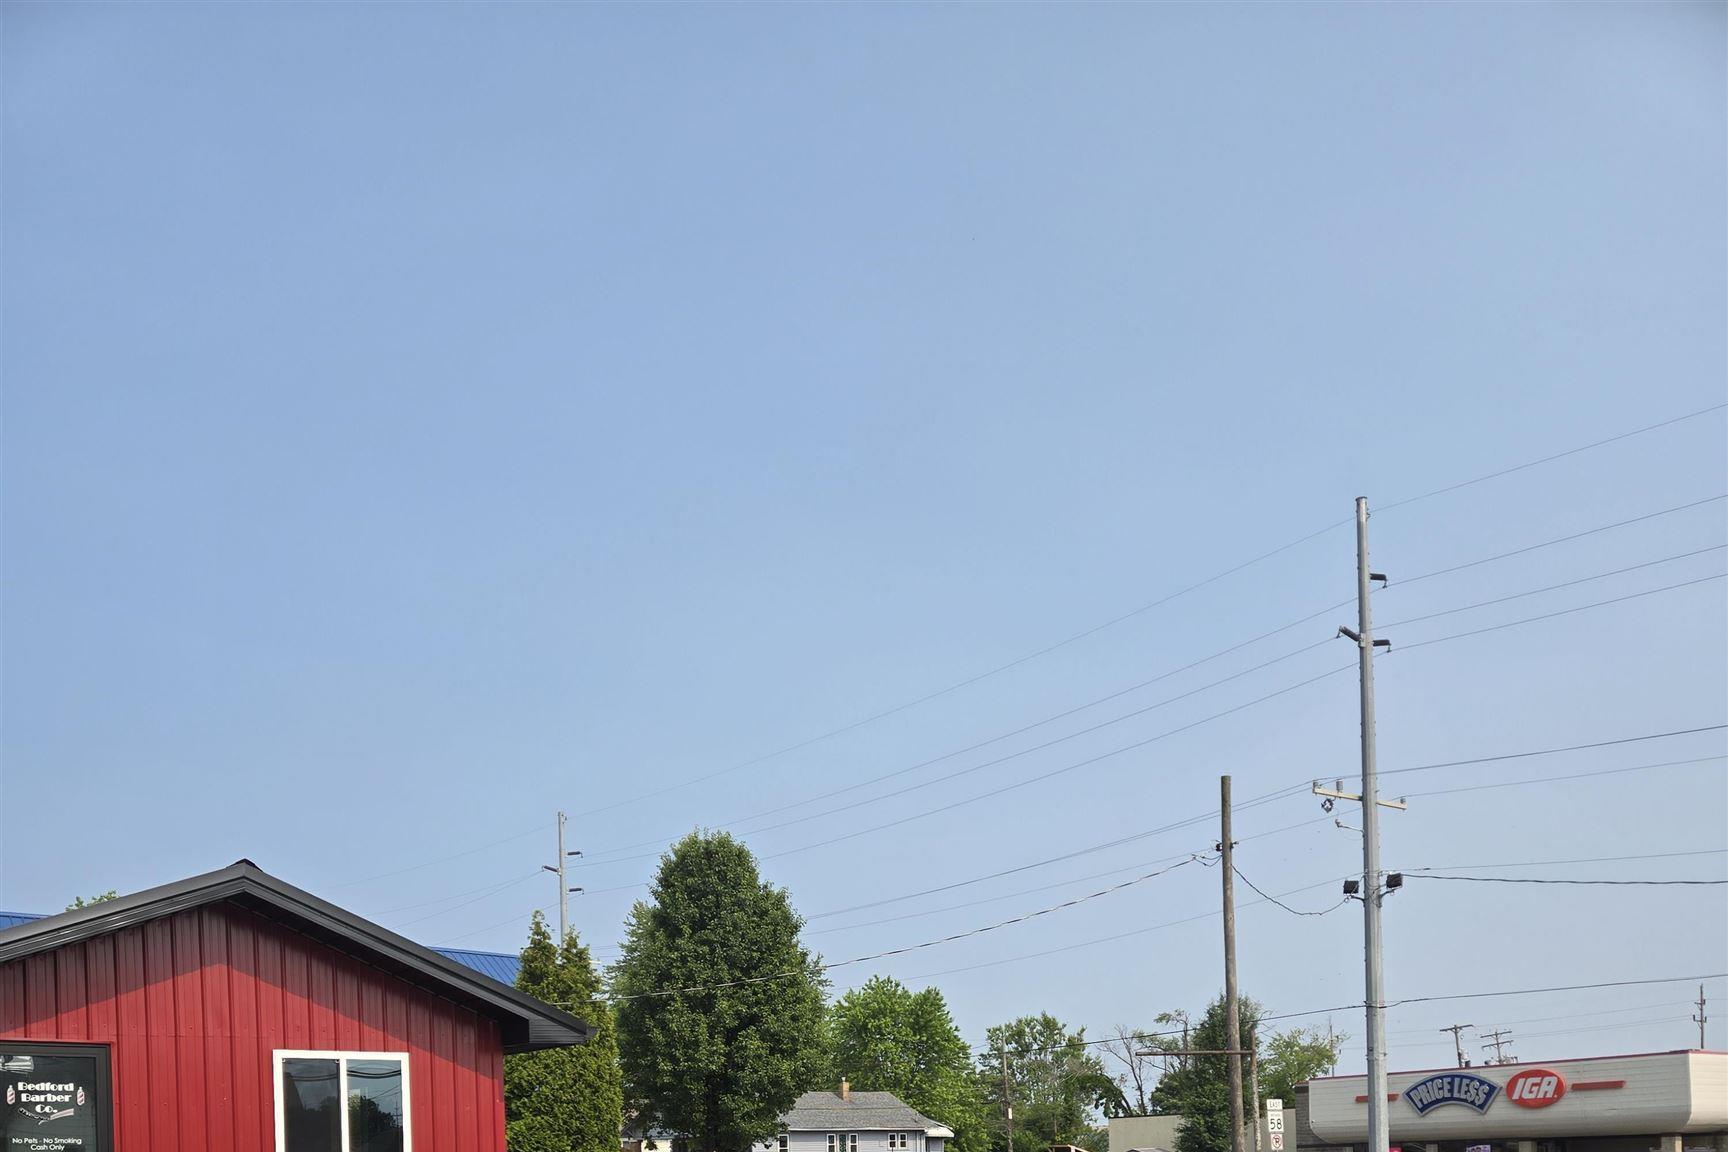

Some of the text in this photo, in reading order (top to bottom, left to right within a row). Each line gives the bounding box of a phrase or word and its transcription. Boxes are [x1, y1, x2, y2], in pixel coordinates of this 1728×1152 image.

[17, 1081, 75, 1092] Bedford
[1512, 1076, 1557, 1100] IGA
[20, 1093, 72, 1102] Barber
[1409, 1077, 1452, 1109] PRICE
[35, 1104, 58, 1113] Co.
[1270, 1118, 1282, 1130] 58
[54, 1137, 82, 1145] Smoking
